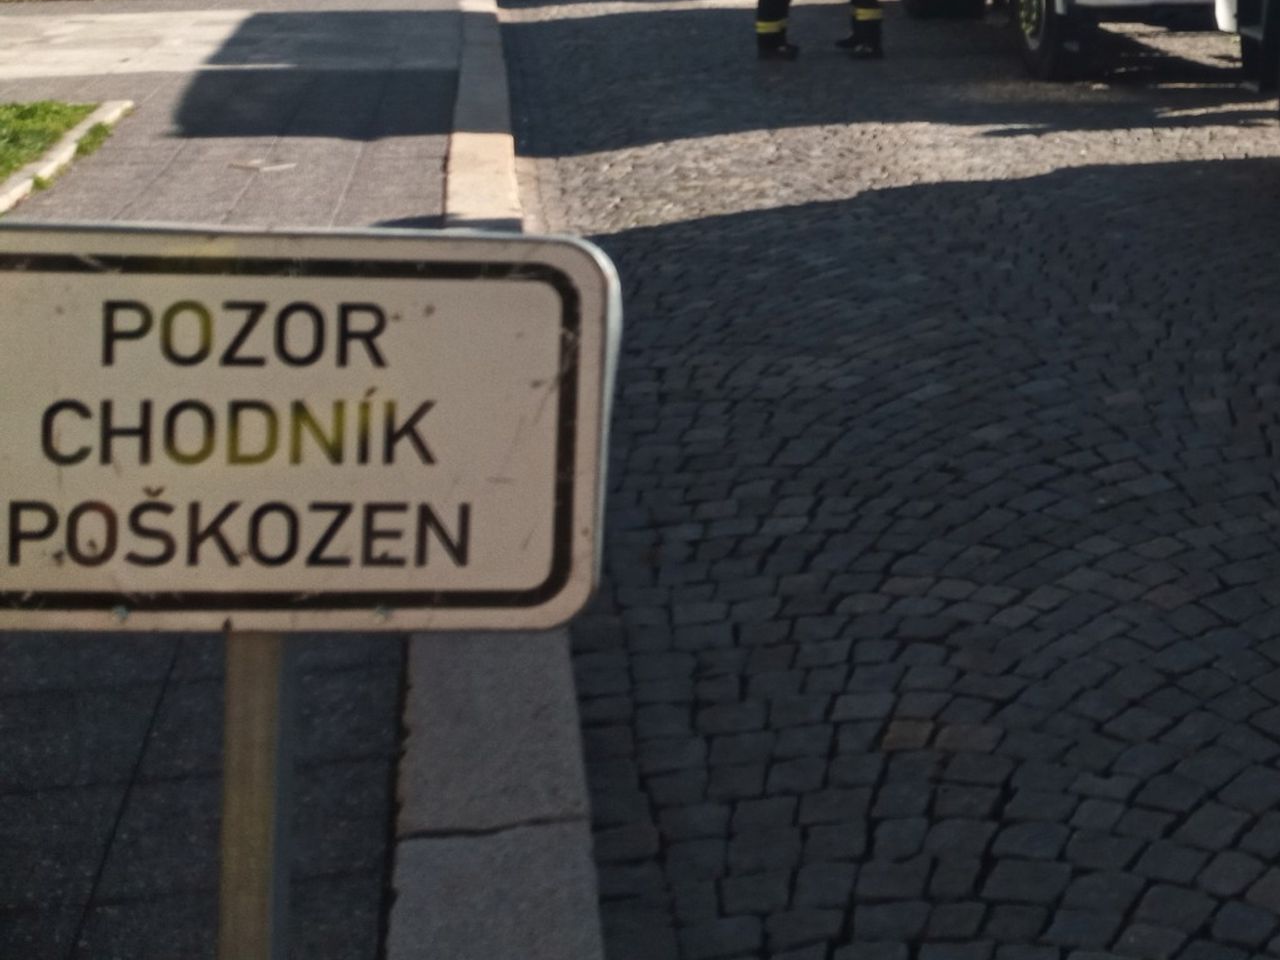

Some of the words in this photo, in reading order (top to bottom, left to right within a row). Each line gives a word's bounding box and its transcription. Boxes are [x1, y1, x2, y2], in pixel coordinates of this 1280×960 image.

[101, 300, 388, 367] POZOR
[40, 387, 437, 466] CHODNÍK
[7, 486, 471, 568] POŠKOZEN
